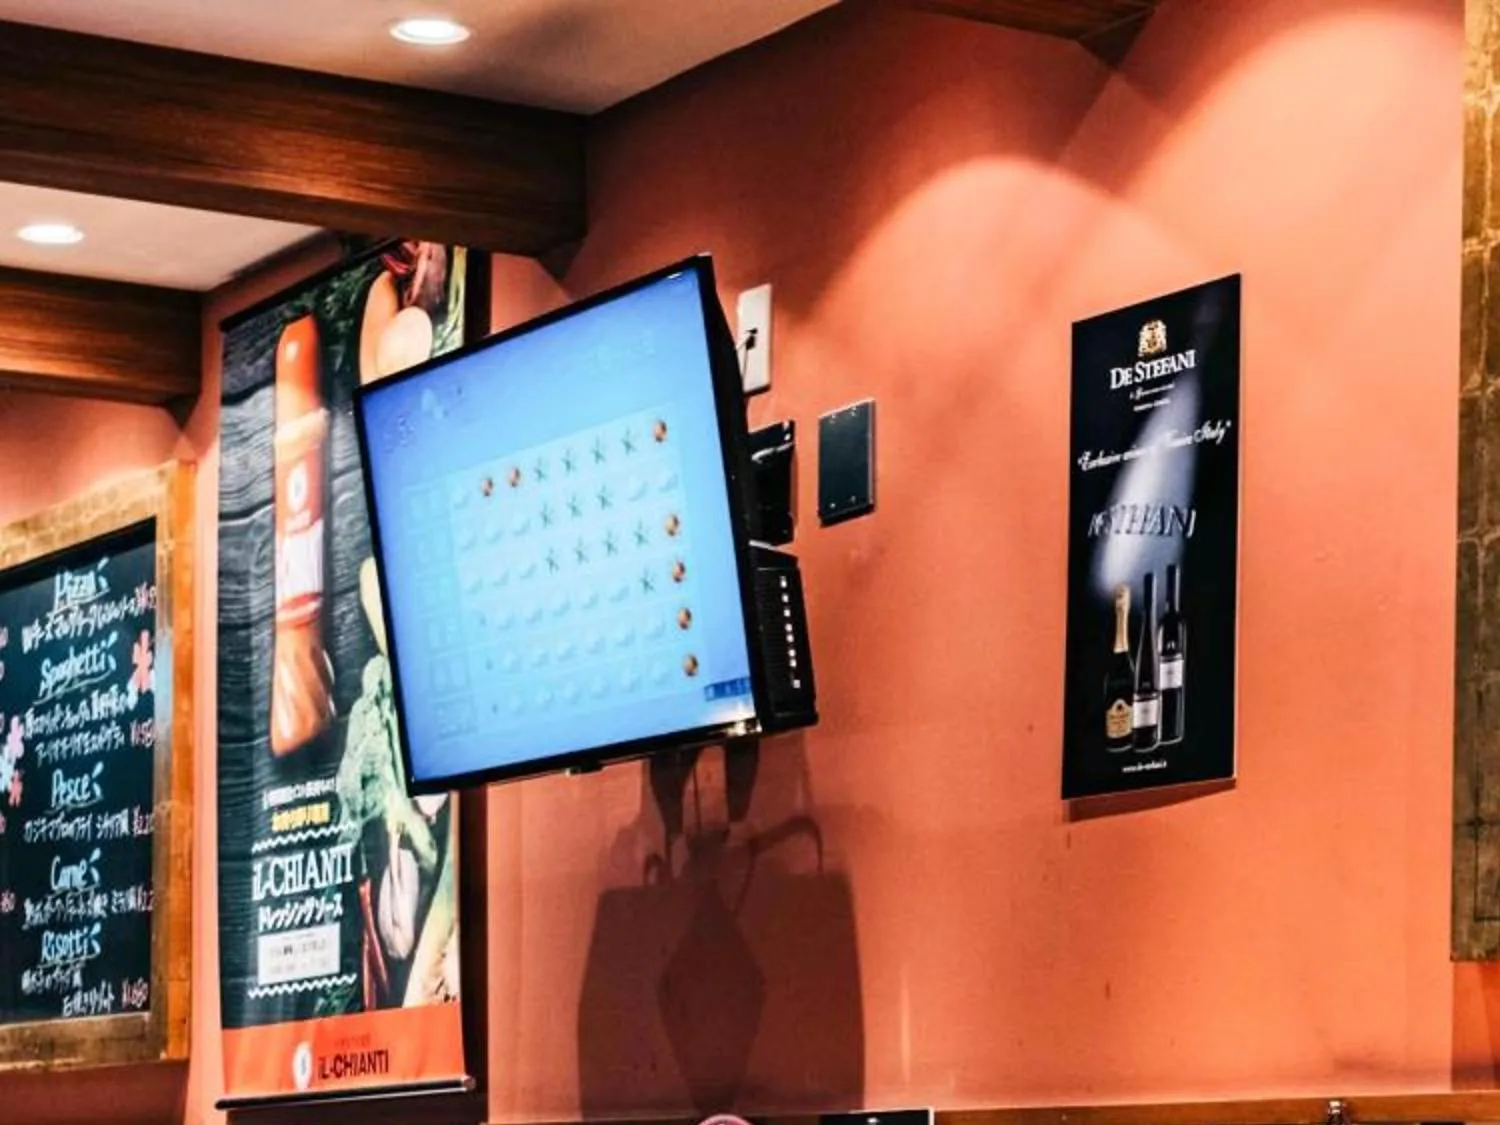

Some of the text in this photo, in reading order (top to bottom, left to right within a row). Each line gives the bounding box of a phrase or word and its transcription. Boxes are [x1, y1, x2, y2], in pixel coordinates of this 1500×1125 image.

[1110, 349, 1196, 389] DE STEFANI
[52, 768, 90, 808] Pesce
